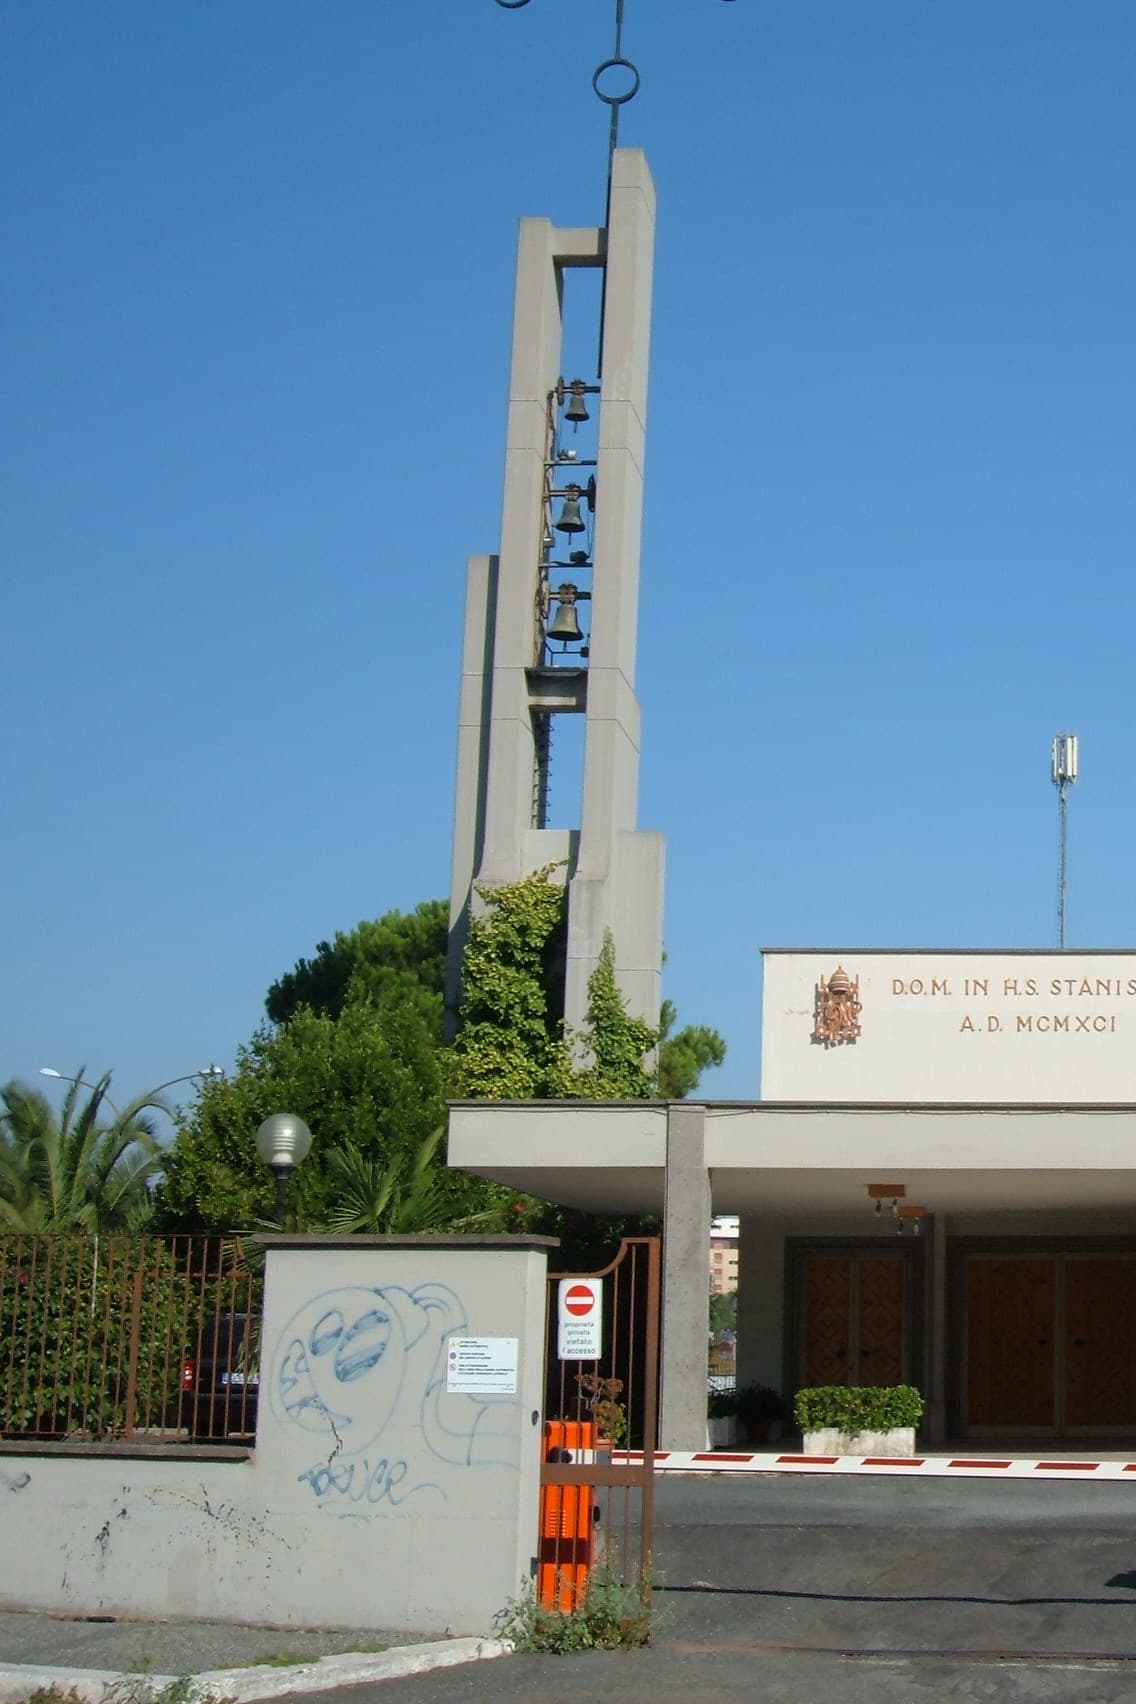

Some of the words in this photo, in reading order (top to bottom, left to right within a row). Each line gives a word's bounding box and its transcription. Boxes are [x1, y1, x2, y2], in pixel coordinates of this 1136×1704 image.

[892, 979, 952, 996] D.O.M.
[964, 979, 988, 996] IN
[1003, 978, 1040, 996] H.S.
[959, 1015, 1003, 1032] A.D.
[1016, 1015, 1116, 1033] MCMXCI
